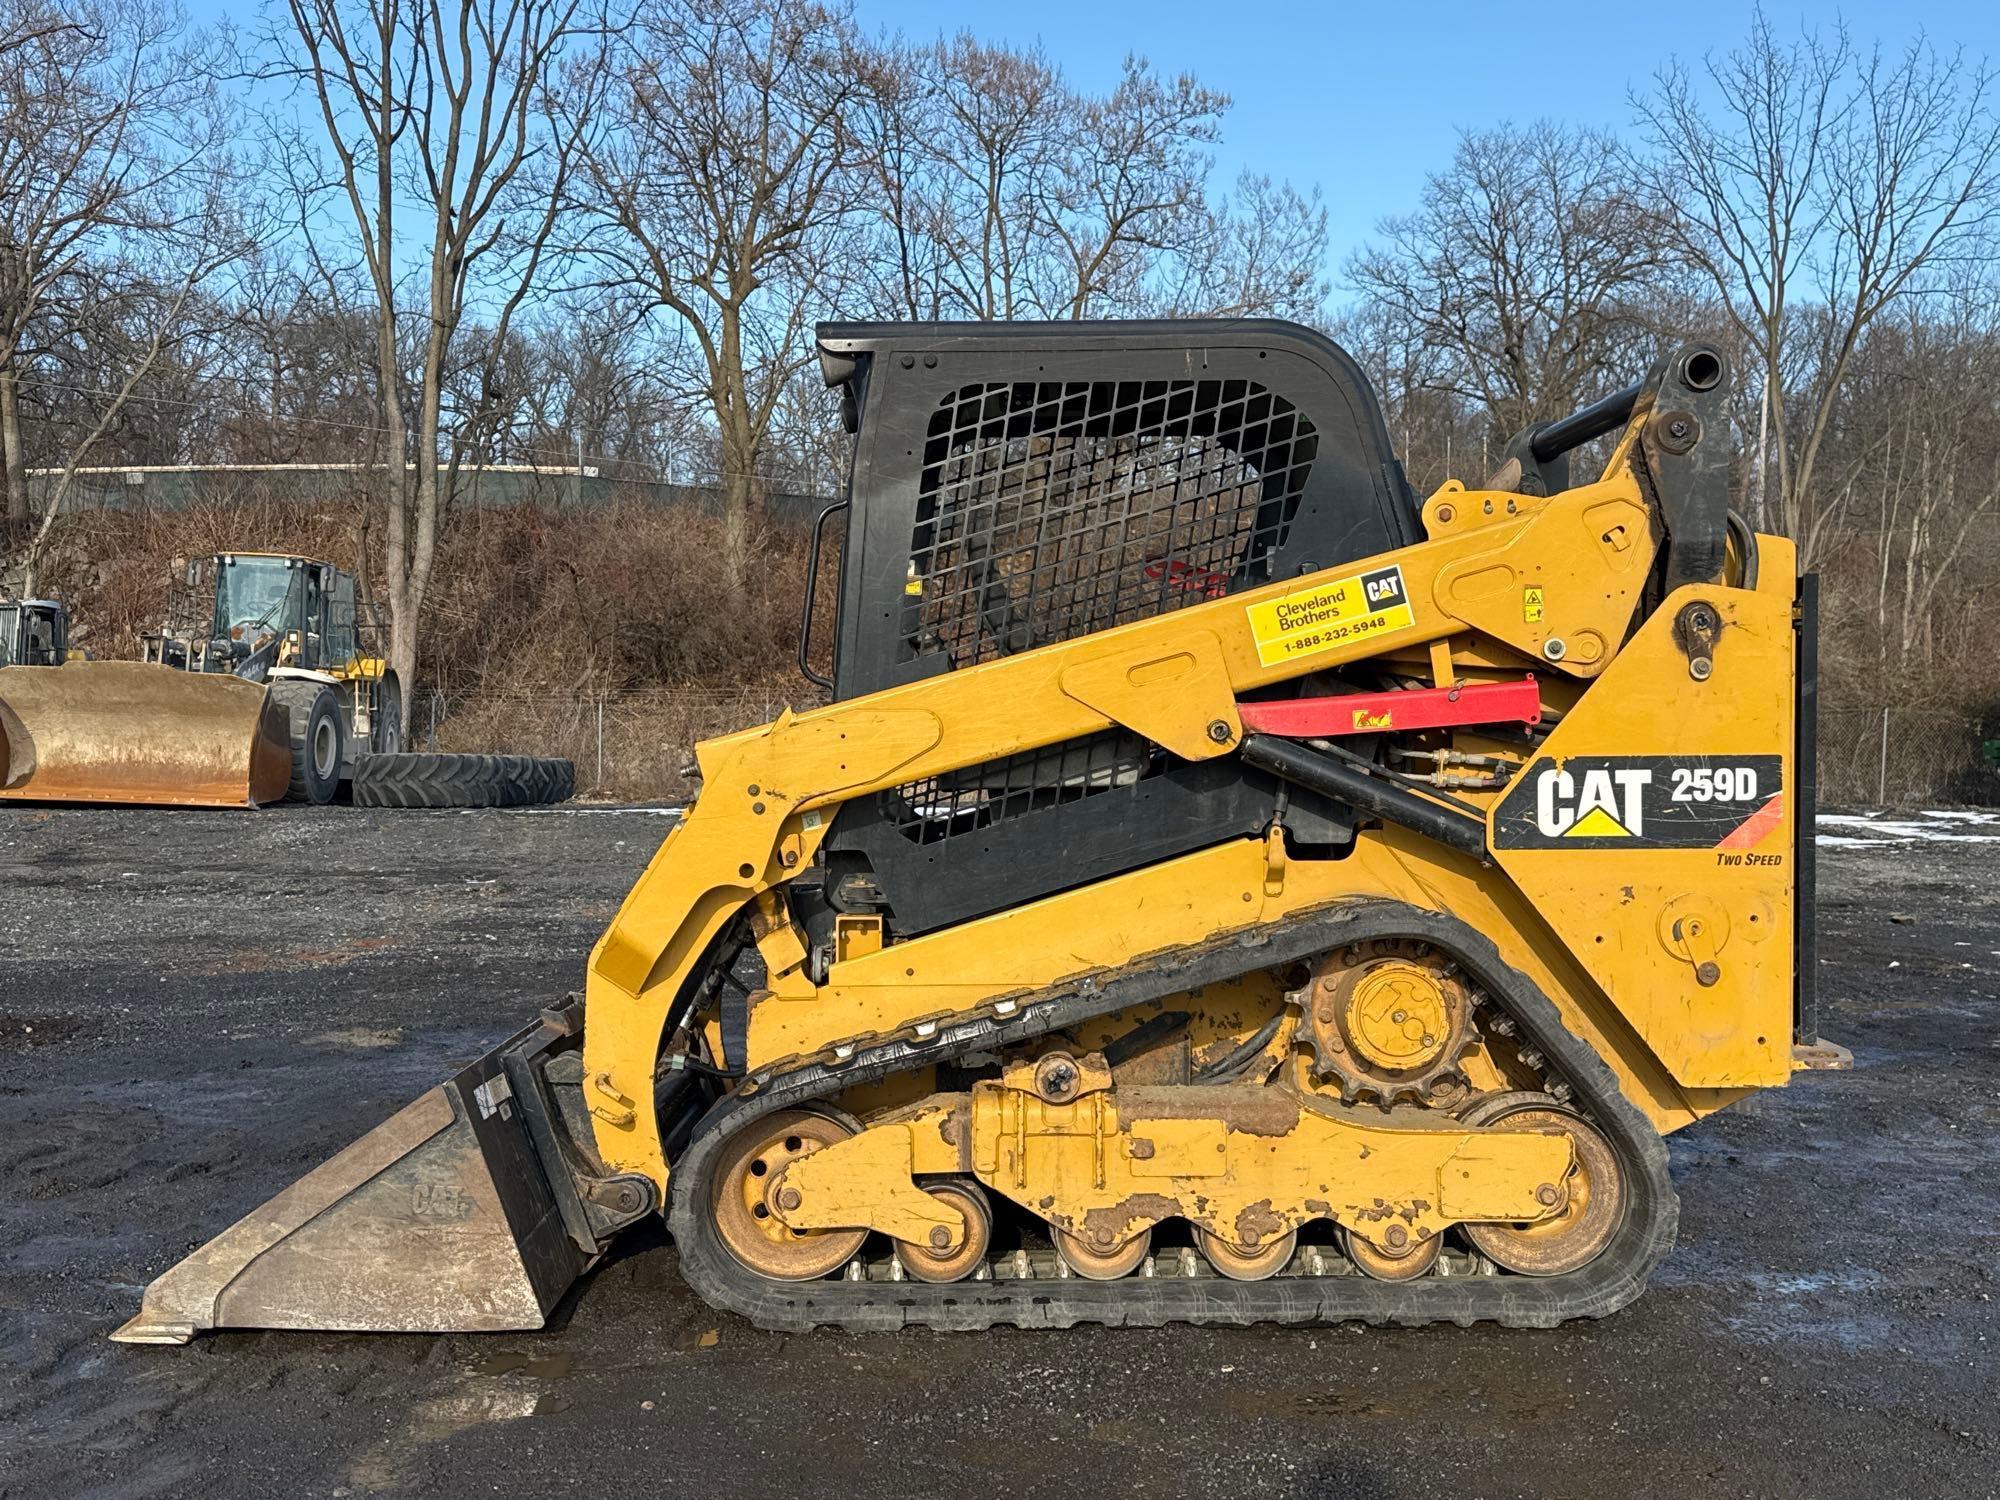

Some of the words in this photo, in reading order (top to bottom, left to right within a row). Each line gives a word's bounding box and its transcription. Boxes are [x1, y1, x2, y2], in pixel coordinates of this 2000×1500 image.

[1276, 588, 1345, 619] Cleveland
[1366, 575, 1399, 601] CAT
[1279, 607, 1340, 631] Brothers
[1284, 617, 1386, 652] 1-888-232-5948
[1537, 769, 1652, 837] CAT
[1671, 768, 1757, 802] 259D
